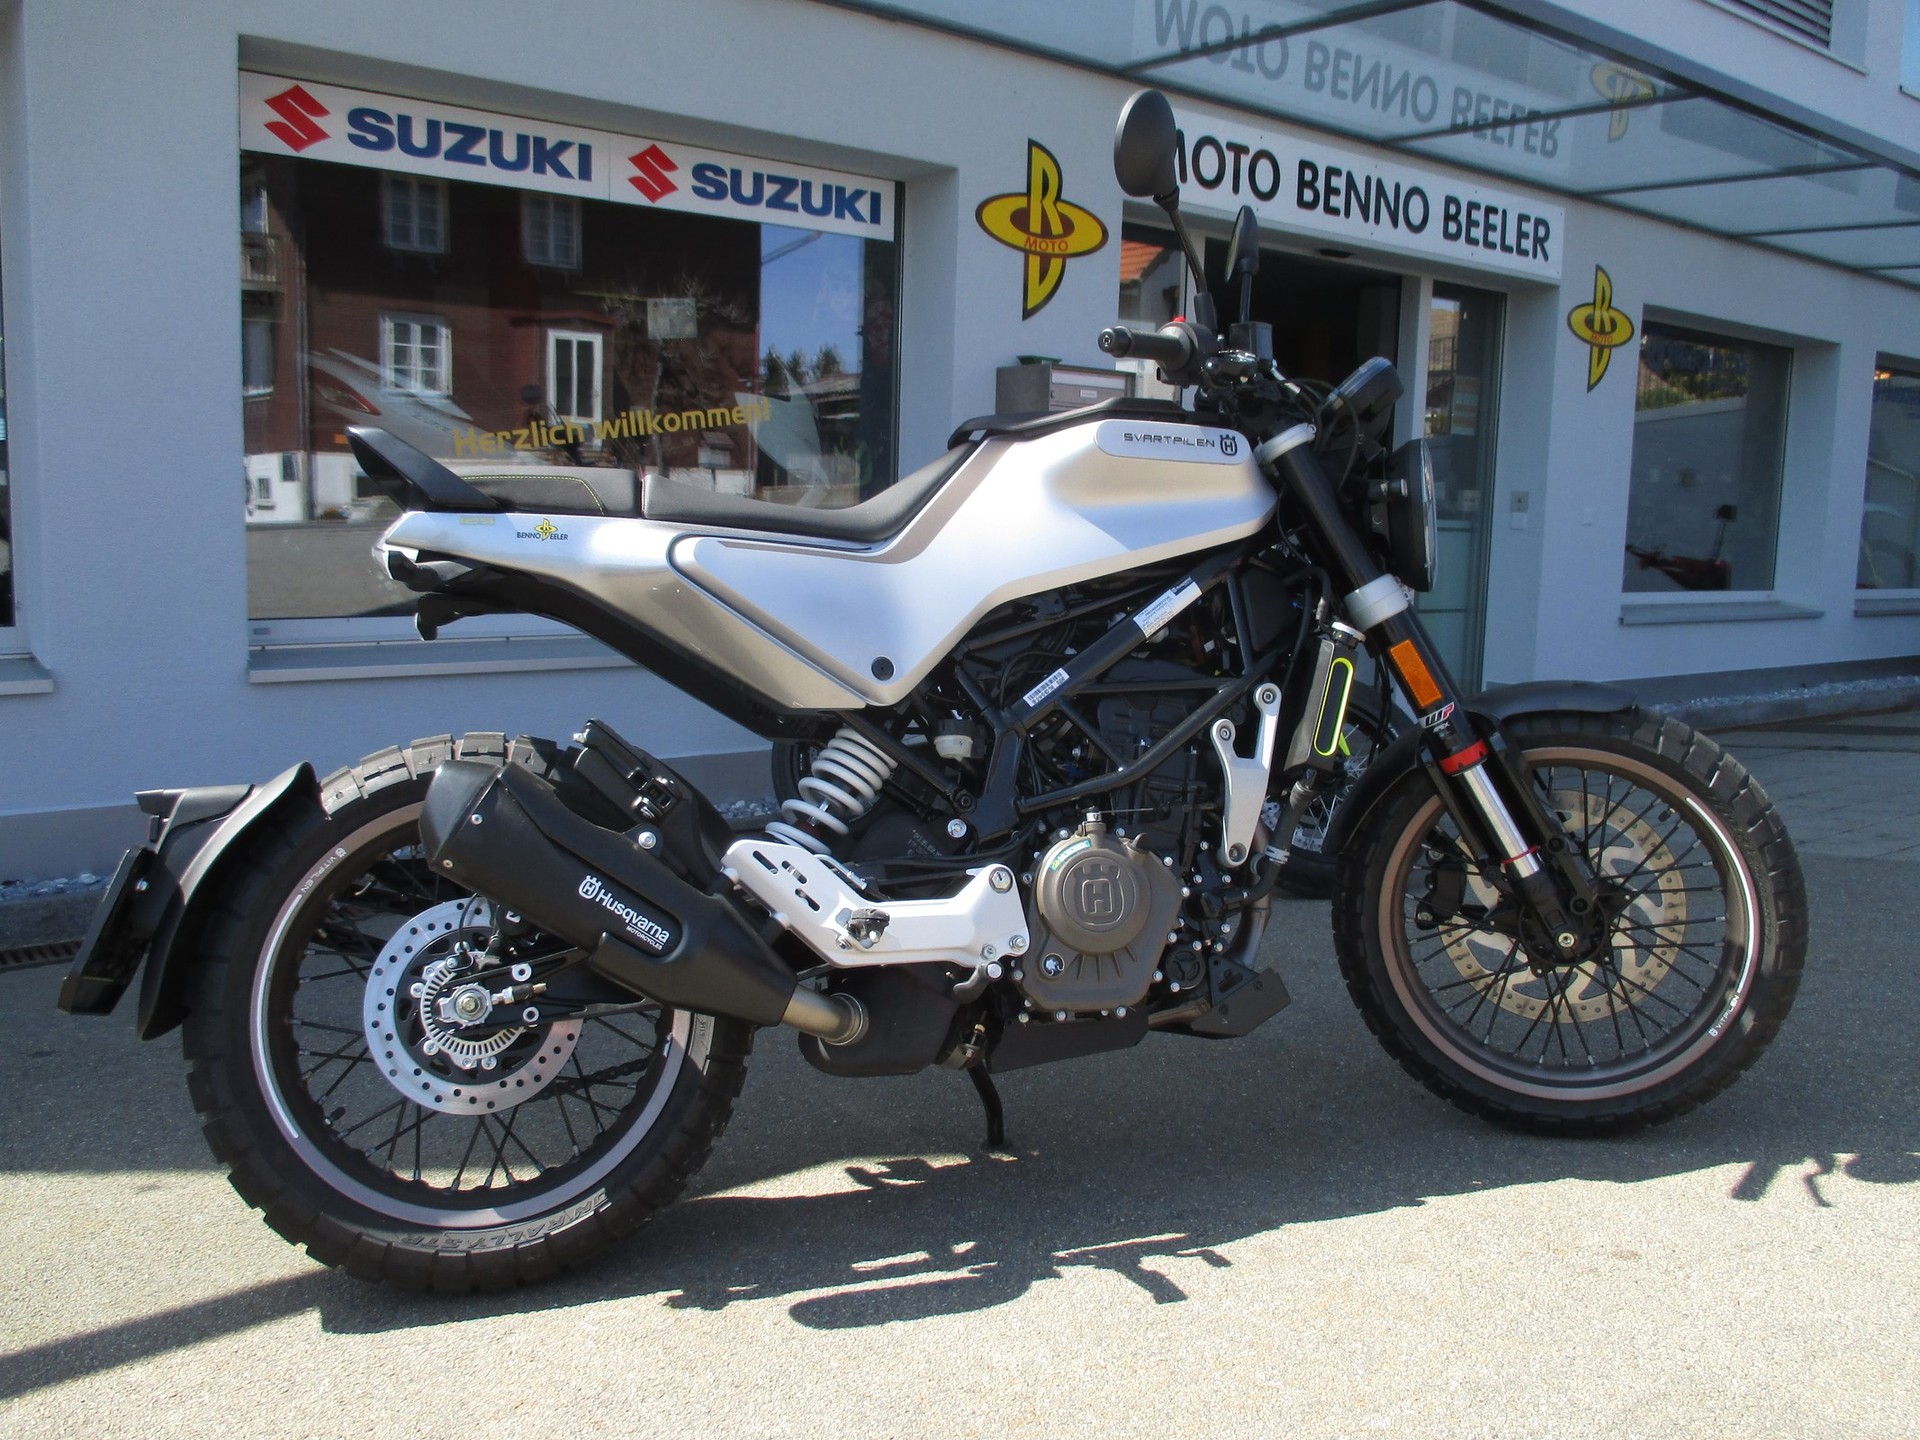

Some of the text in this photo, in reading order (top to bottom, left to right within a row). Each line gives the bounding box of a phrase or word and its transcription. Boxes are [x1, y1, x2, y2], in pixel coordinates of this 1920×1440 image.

[347, 107, 593, 182] SUZUKI
[691, 161, 882, 226] SUZUKI
[1296, 158, 1430, 234] BENNO
[1442, 194, 1550, 262] BEELER
[1024, 236, 1069, 252] MOTO
[452, 418, 586, 457] Herzlich
[595, 397, 771, 440] willkommen!
[1123, 432, 1215, 448] SVARTPILEN
[516, 531, 541, 540] BENNO
[301, 857, 336, 892] VITPILEN
[595, 888, 670, 944] Husqvarna
[625, 924, 663, 951] MOTORCYCLES
